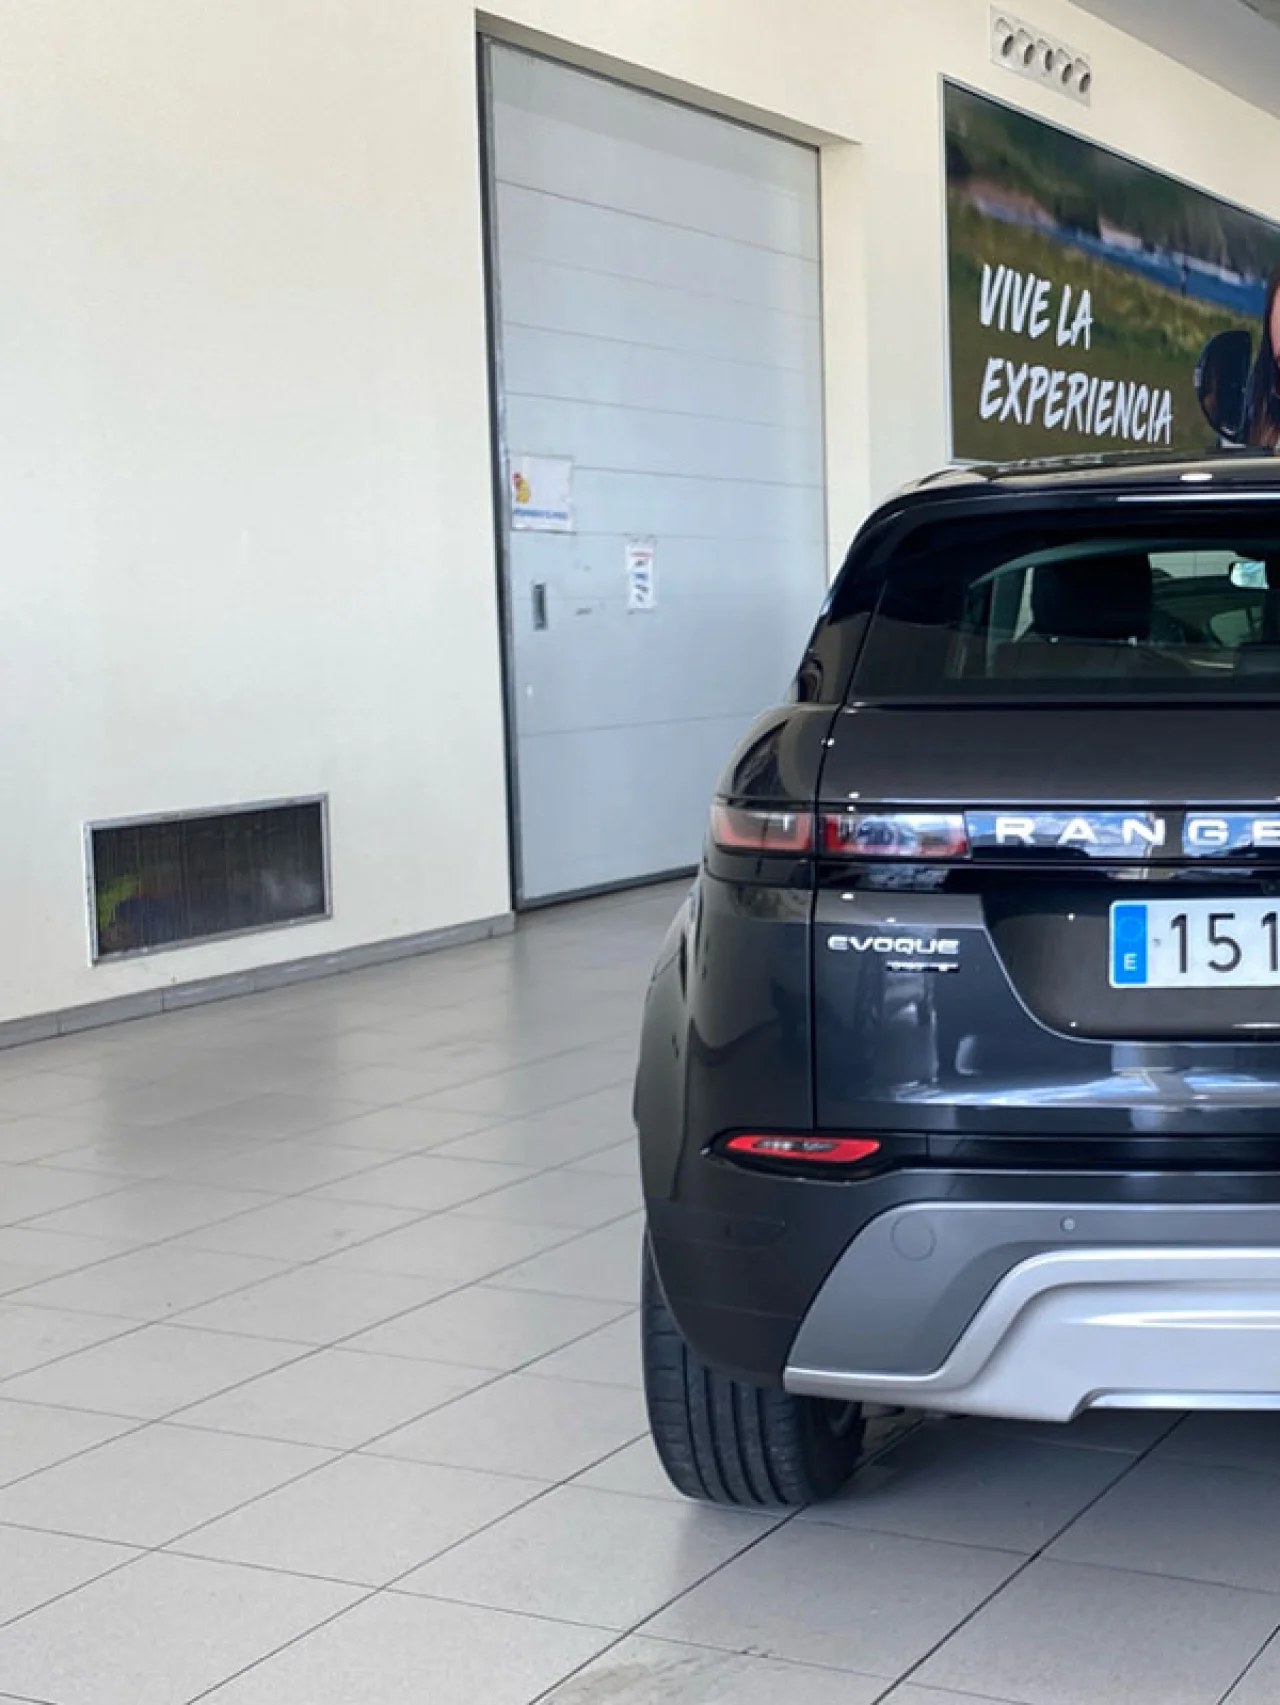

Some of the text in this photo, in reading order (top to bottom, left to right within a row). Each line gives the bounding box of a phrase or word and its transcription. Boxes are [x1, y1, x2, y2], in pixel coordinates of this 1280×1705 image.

[979, 263, 1093, 350] VIVE LA
[979, 356, 1173, 445] EXPERIENCIA
[828, 935, 960, 955] EVOQUE
[1123, 953, 1138, 972] E
